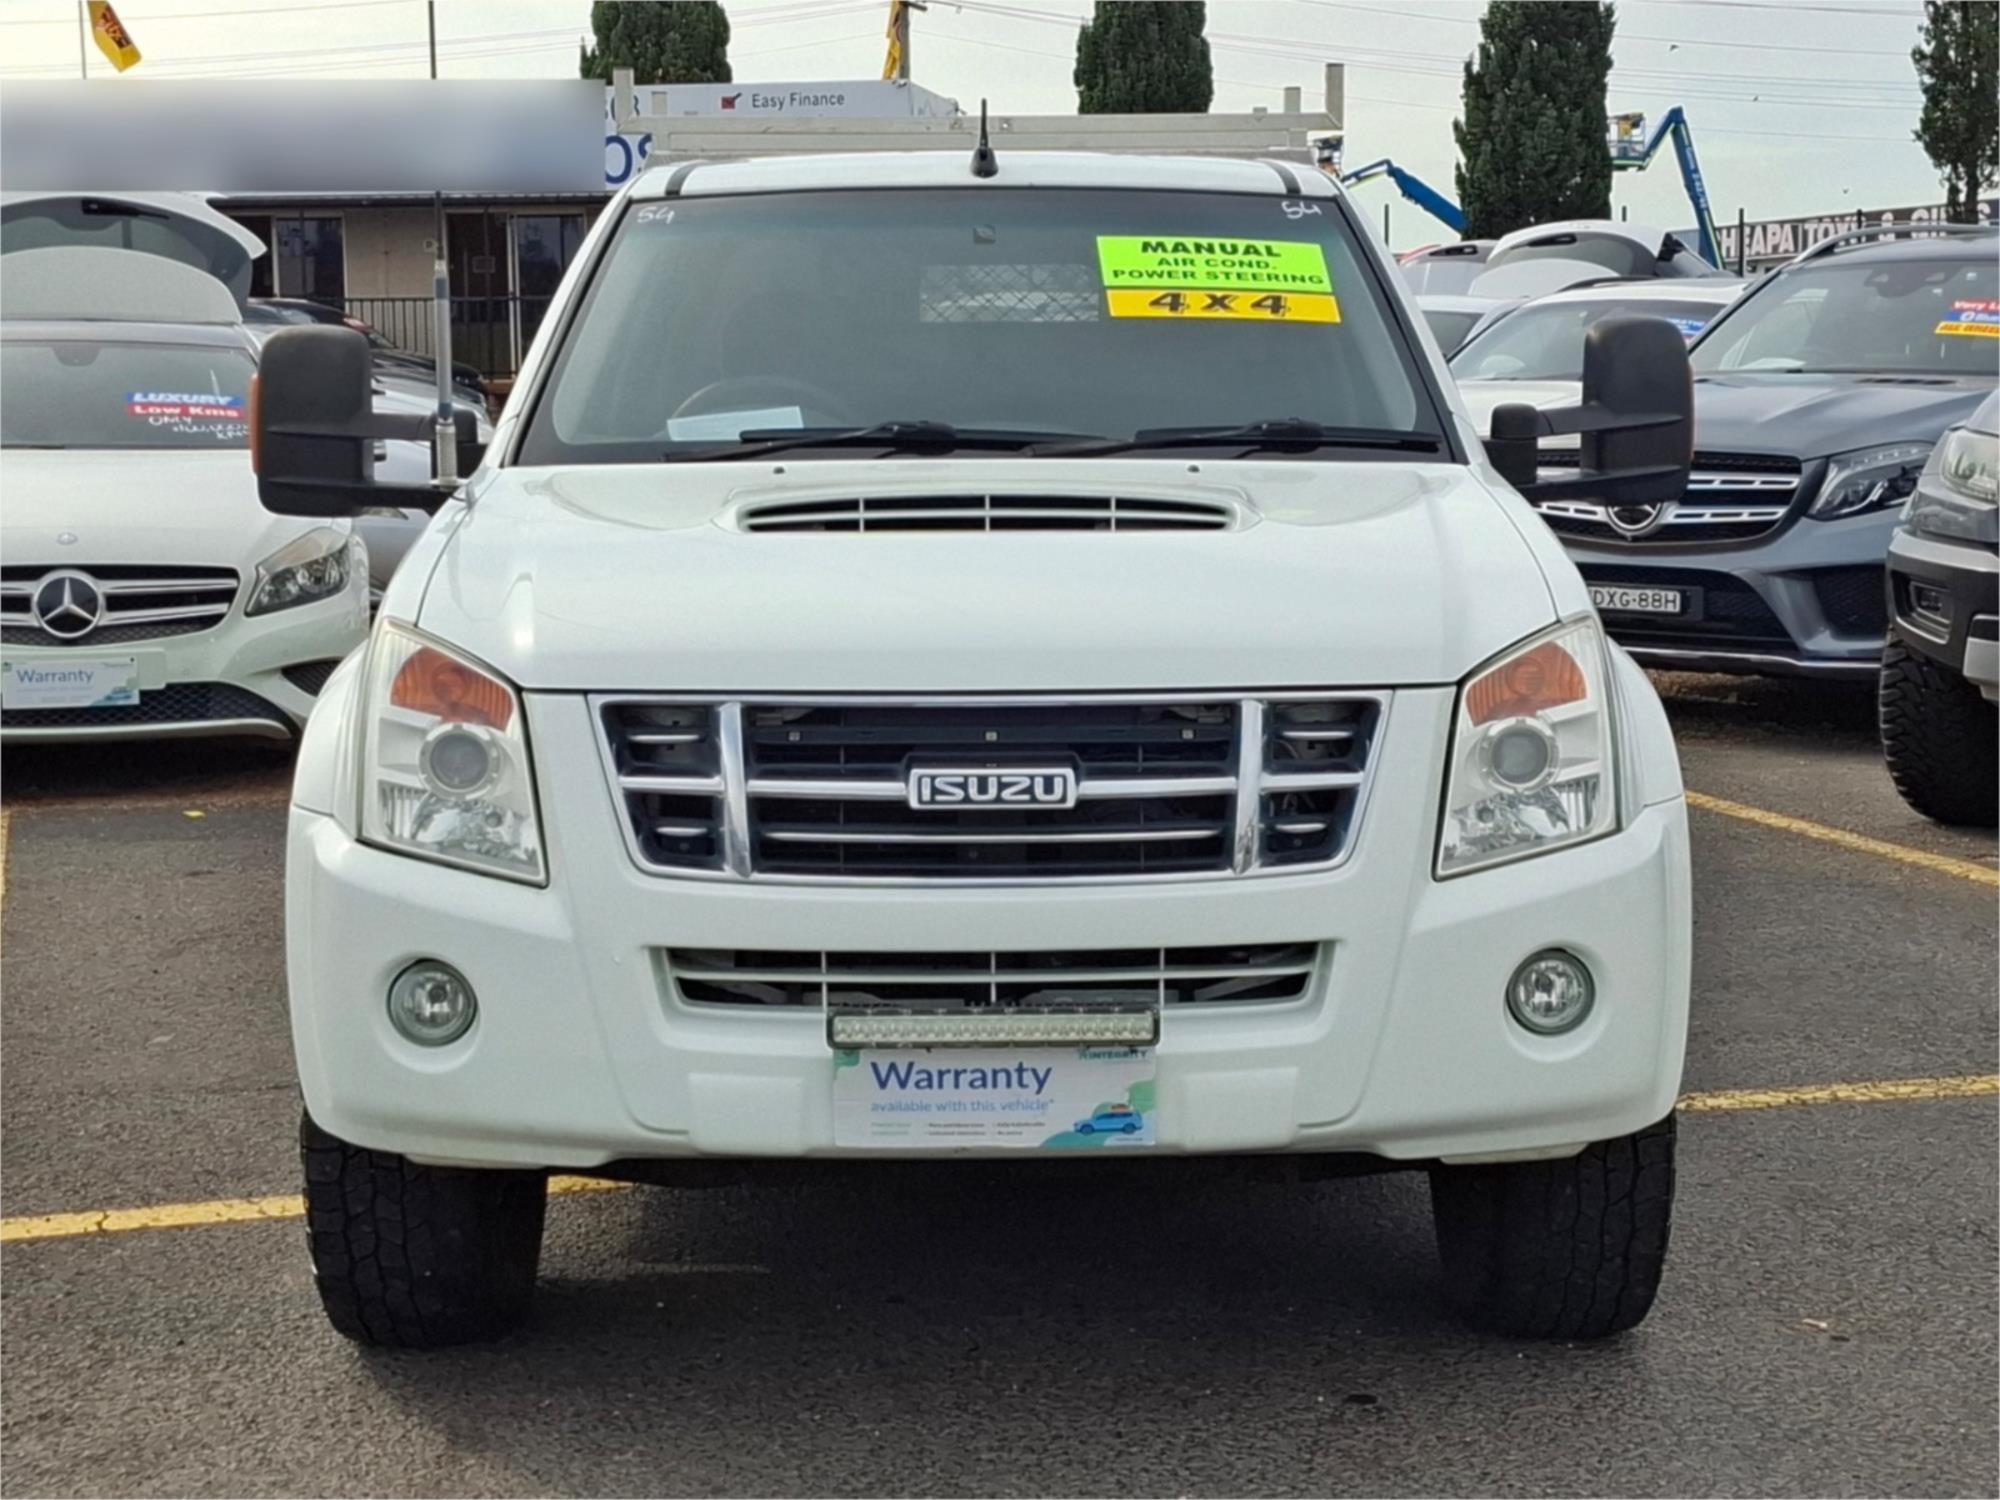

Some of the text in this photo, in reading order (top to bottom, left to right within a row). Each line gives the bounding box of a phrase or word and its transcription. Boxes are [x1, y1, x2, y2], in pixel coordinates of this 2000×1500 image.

[752, 92, 845, 111] Easy Finance
[1141, 241, 1281, 257] MANUAL
[1716, 224, 1795, 258] HEAPA
[1157, 257, 1277, 270] AIR COND.
[1113, 269, 1325, 285] POWER STEERING
[1149, 292, 1190, 314] 4
[1251, 294, 1291, 317] 4
[133, 392, 233, 406] LUXURY
[134, 405, 239, 418] Low Kms
[16, 668, 94, 685] Warranty
[921, 776, 1064, 802] ISUZU
[870, 1061, 1053, 1095] Warranty
[870, 1098, 931, 1112] available
[936, 1098, 967, 1112] with
[970, 1097, 996, 1111] this
